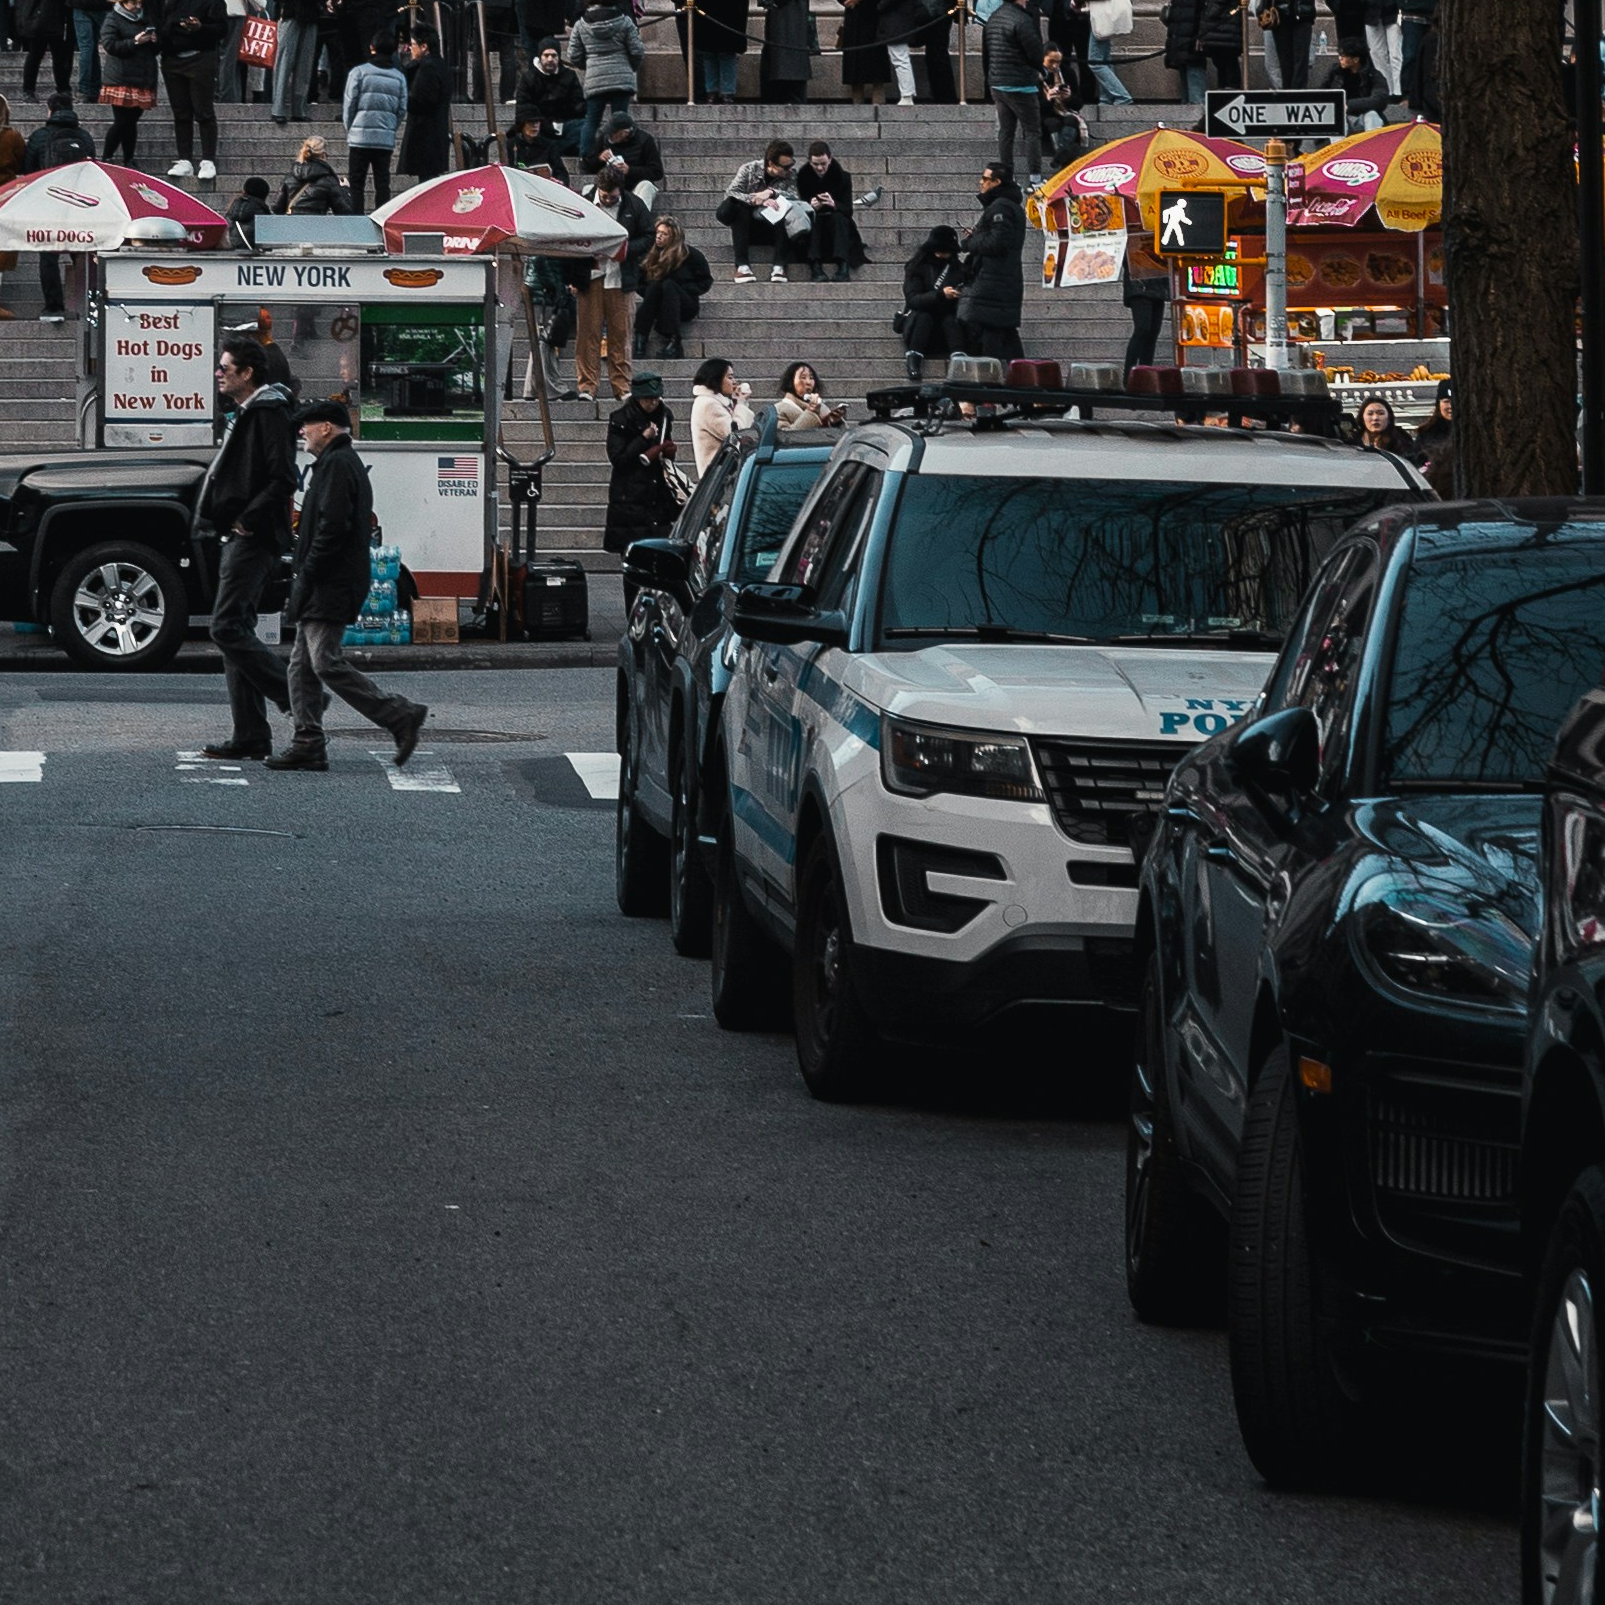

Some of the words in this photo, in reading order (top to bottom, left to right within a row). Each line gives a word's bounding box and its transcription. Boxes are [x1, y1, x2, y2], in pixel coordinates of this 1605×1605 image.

[246, 20, 276, 42] THE
[240, 37, 274, 58] MET
[1228, 105, 1267, 123] ONE
[1285, 104, 1327, 123] WAY
[1402, 208, 1426, 220] Beef
[26, 229, 52, 243] HOT
[57, 230, 94, 244] DOGS
[237, 265, 286, 287] NEW
[293, 266, 351, 287] YORK
[139, 313, 180, 329] Best
[117, 339, 150, 356] Hot
[156, 339, 203, 360] Dogs
[150, 365, 168, 383] in
[113, 393, 156, 409] New
[162, 392, 205, 409] York
[437, 480, 478, 488] DISABLED
[438, 489, 477, 497] VETERAN
[1185, 699, 1257, 711] NY
